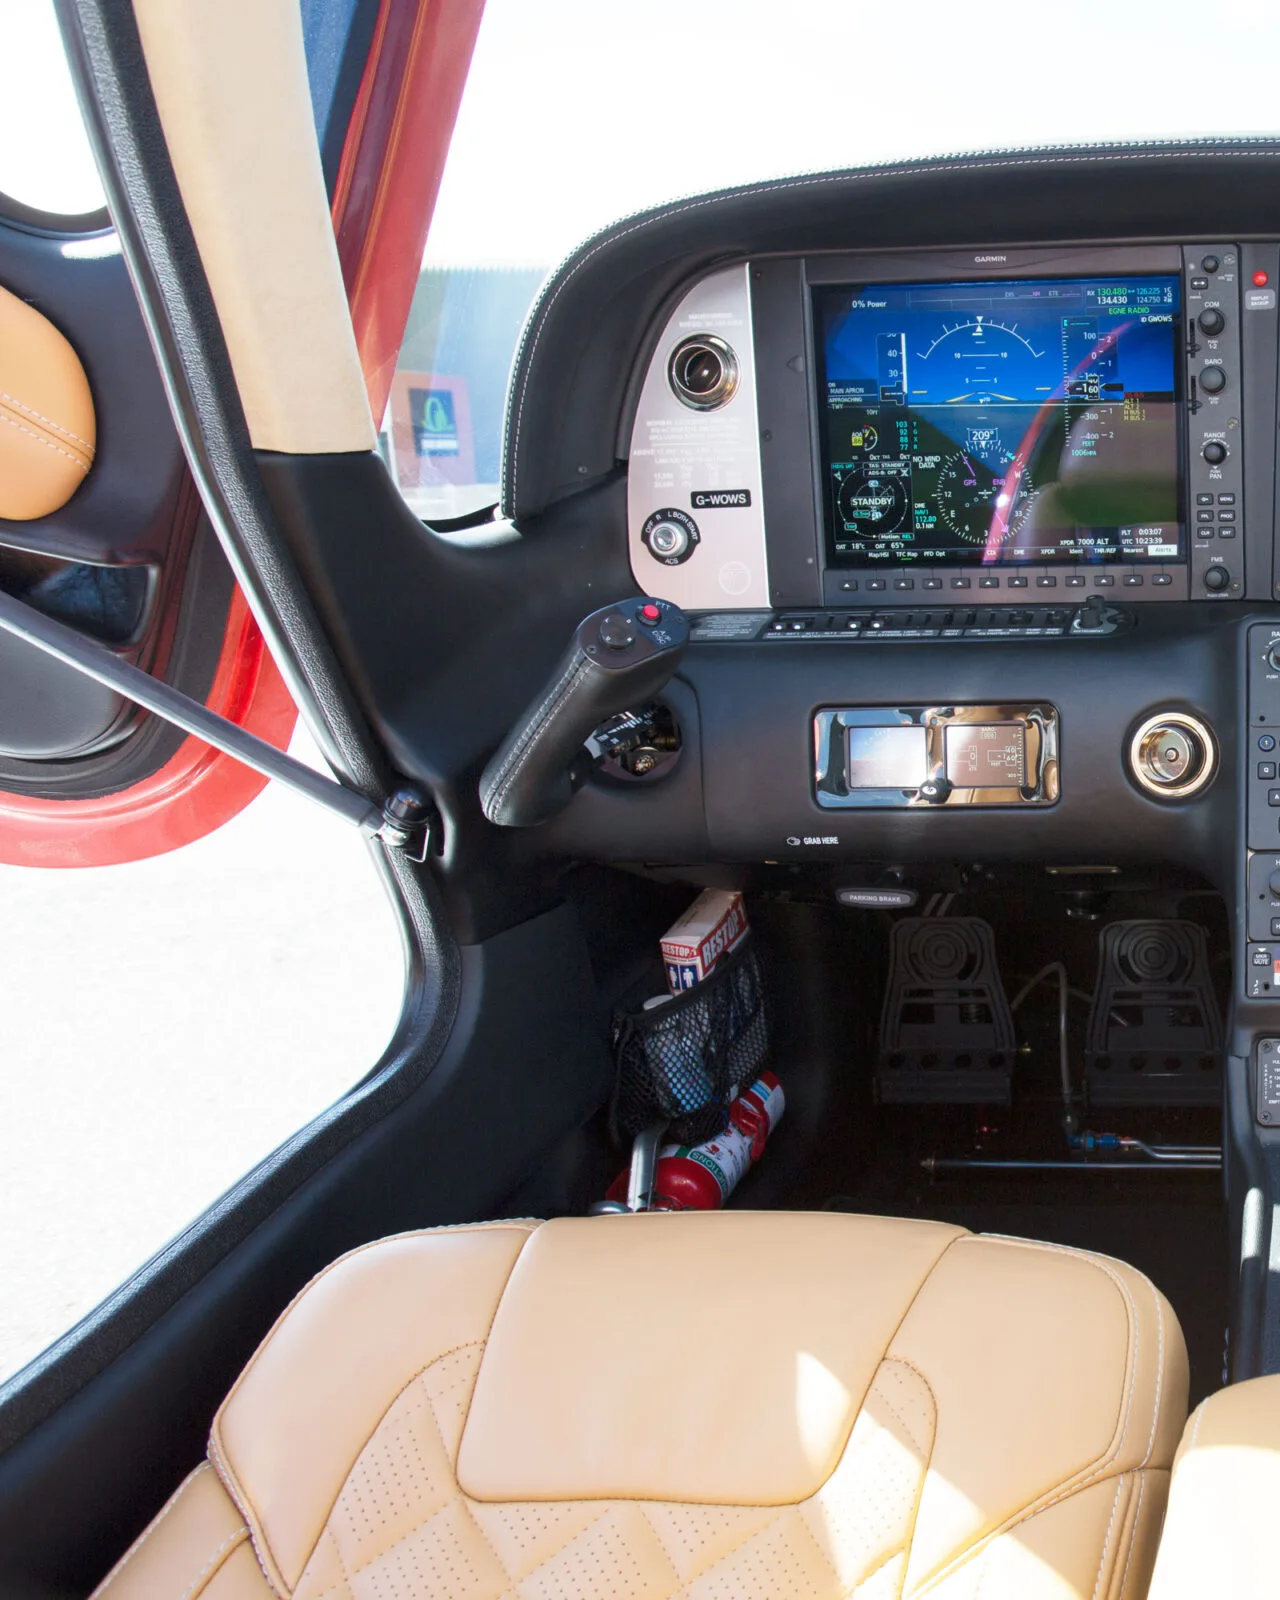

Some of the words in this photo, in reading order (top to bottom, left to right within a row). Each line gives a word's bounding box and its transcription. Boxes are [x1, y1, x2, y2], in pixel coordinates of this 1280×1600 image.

[852, 300, 865, 308] 0%
[867, 300, 887, 308] Power
[972, 431, 994, 440] 209°
[696, 493, 747, 506] G-WOWS
[852, 498, 892, 506] STANDBY
[645, 520, 654, 533] OFF
[672, 511, 689, 523] BOTH
[687, 521, 698, 540] START
[665, 557, 679, 565] ACS
[655, 600, 671, 611] PTT
[803, 836, 821, 845] GRAB
[821, 836, 839, 845] HERE
[849, 894, 878, 902] PARKING
[702, 909, 740, 967] RESTOP
[662, 943, 690, 957] RESTOP
